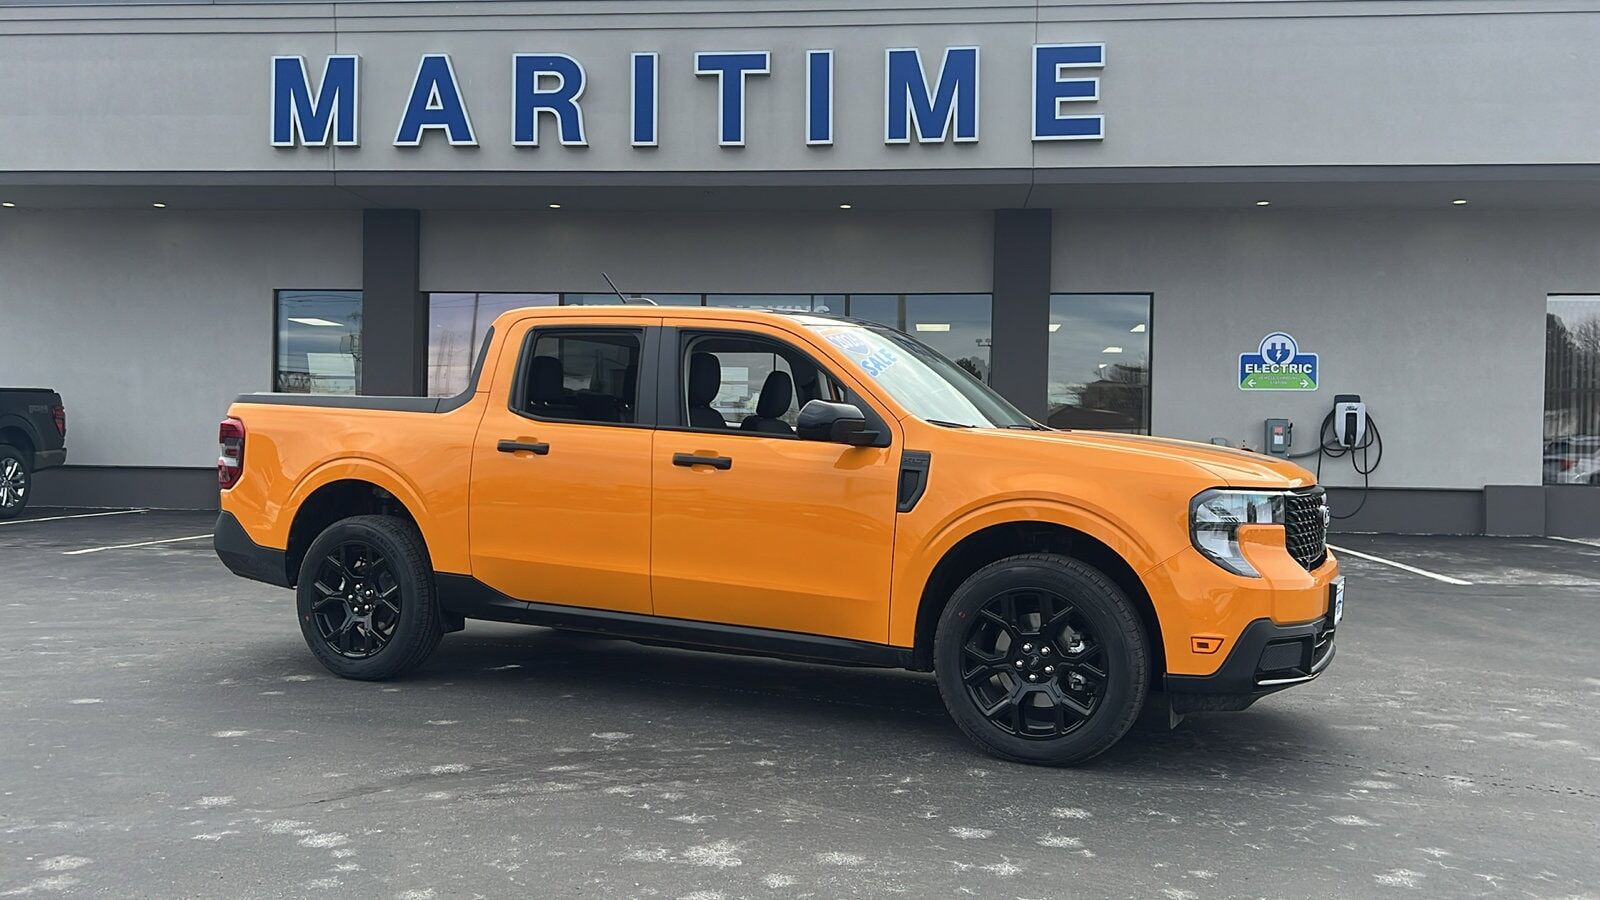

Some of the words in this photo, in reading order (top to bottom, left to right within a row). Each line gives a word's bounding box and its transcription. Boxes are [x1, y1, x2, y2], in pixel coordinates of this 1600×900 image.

[270, 42, 1105, 149] MARITIME
[861, 348, 898, 377] SALE
[1245, 363, 1313, 374] ELECTRIC
